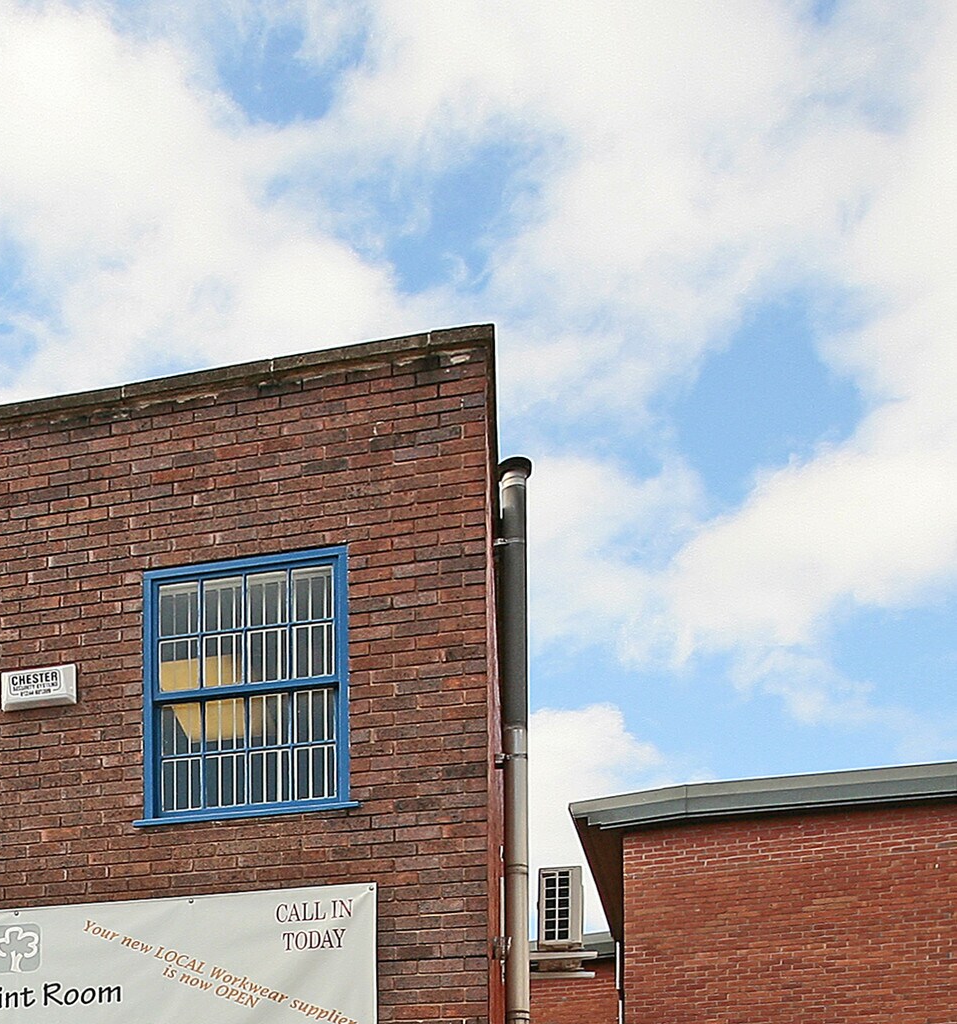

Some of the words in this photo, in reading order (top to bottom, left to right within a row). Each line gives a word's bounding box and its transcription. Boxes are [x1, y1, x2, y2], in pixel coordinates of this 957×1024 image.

[11, 671, 58, 686] CHESTER
[275, 903, 326, 922] CALL
[331, 900, 353, 917] IN
[282, 928, 346, 951] TODAY
[83, 919, 119, 941] Your
[120, 935, 153, 954] new
[154, 946, 206, 974] LOCAL
[210, 966, 288, 1003] Workwear
[43, 982, 122, 1007] Room
[162, 965, 175, 979] is
[179, 974, 212, 991] now
[215, 984, 260, 1008] OPEN
